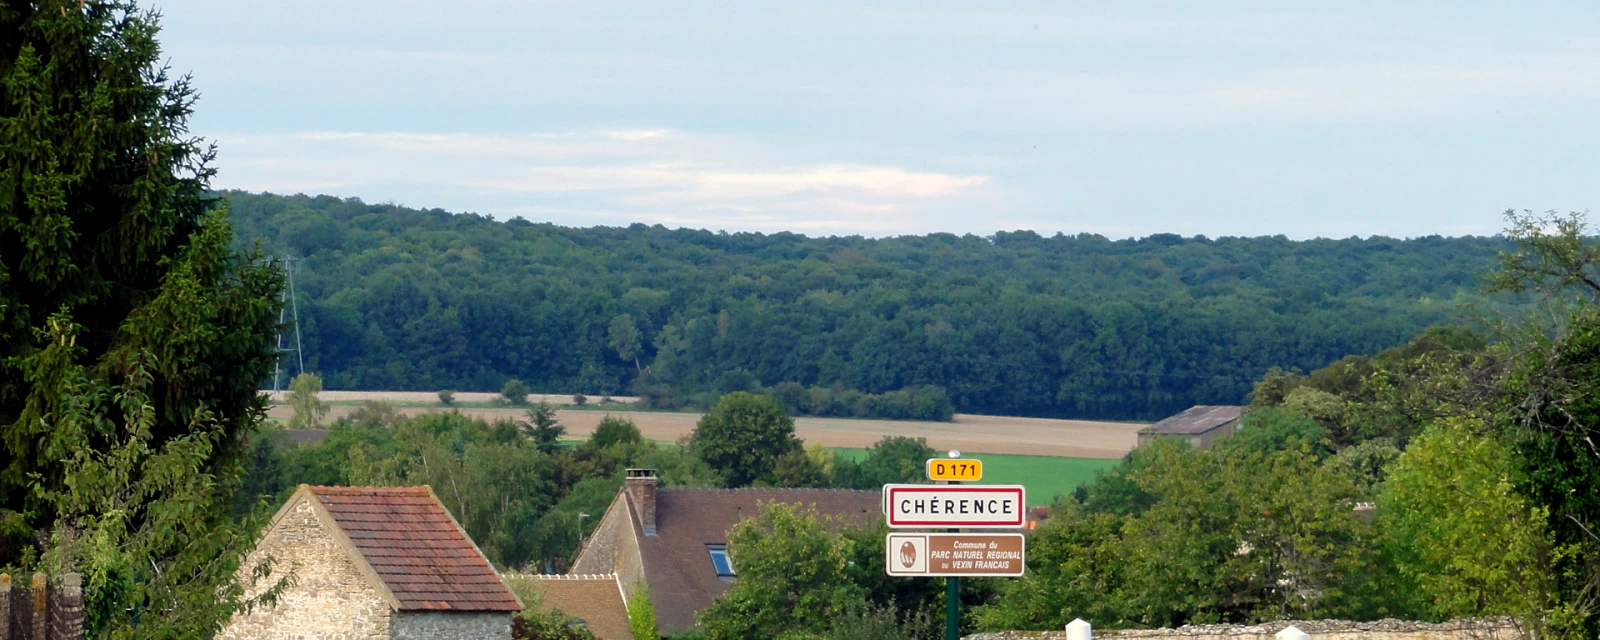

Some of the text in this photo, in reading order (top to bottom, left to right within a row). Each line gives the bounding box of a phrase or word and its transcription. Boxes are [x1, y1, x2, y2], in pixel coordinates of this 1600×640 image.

[937, 464, 975, 475] D 171
[901, 496, 1011, 514] CHÉRENCE
[953, 540, 998, 549] Commune du
[931, 550, 950, 559] PARC
[953, 550, 983, 559] NATUREL
[952, 560, 972, 569] VEXIN
